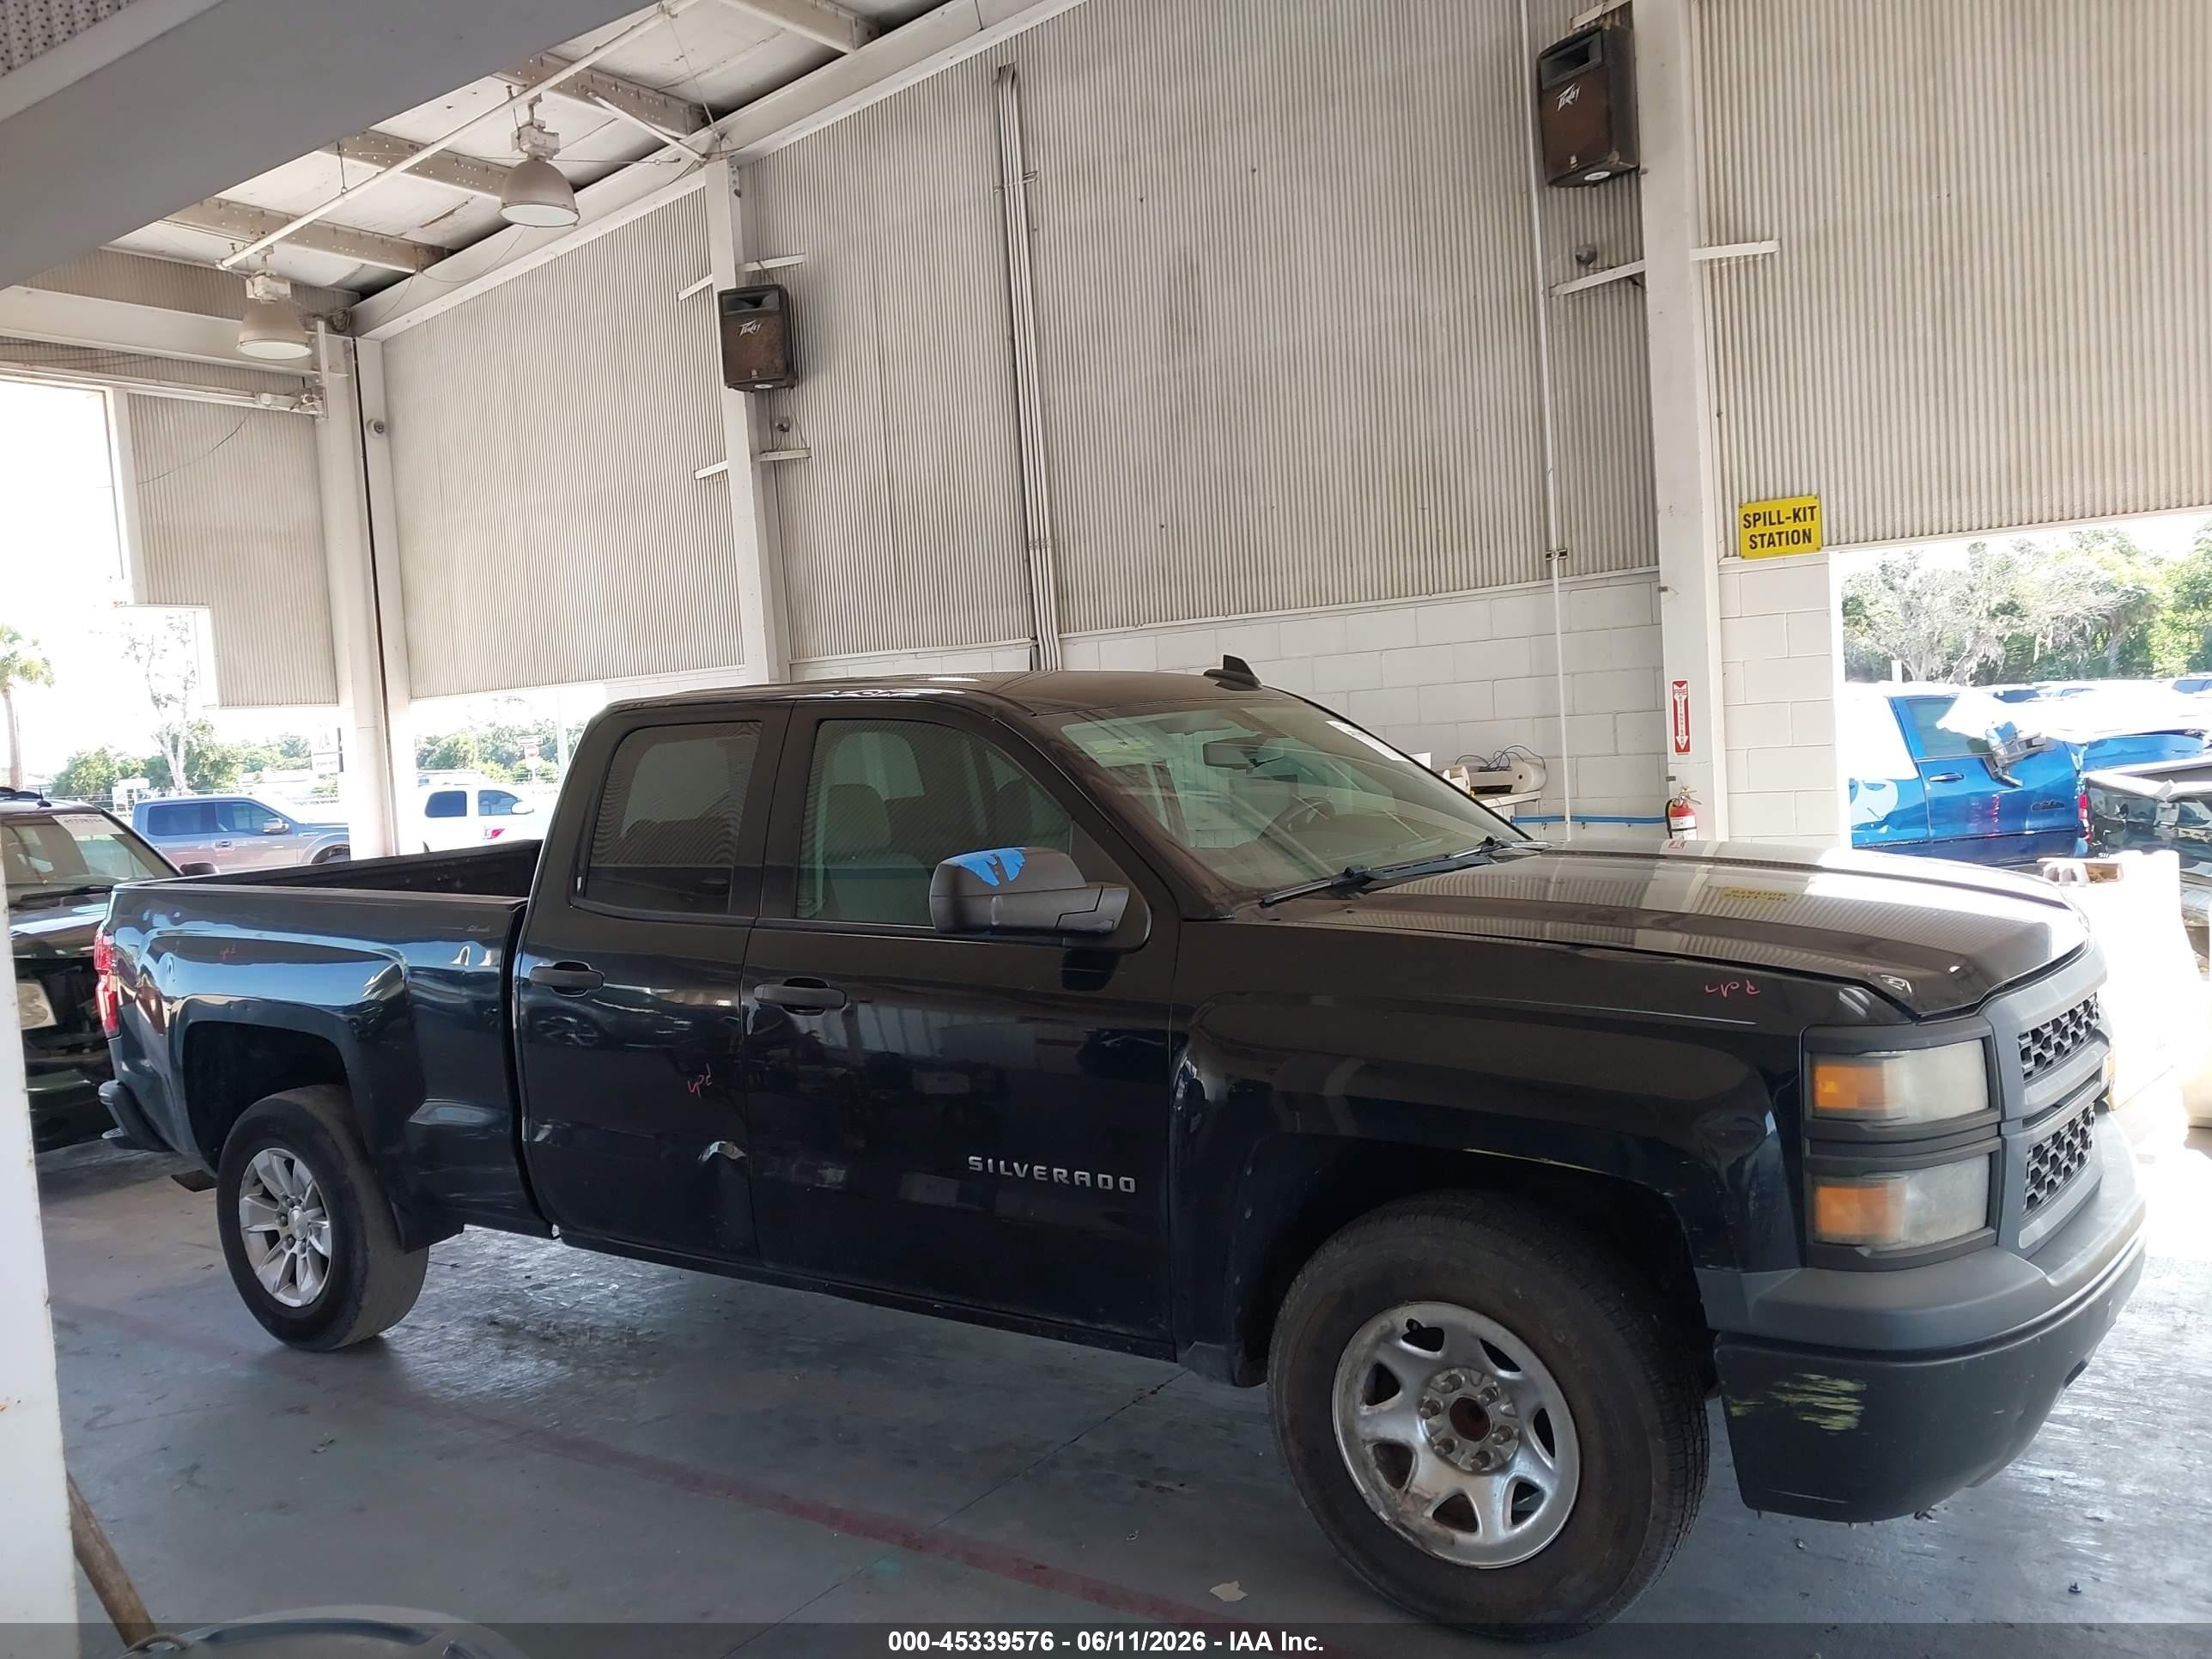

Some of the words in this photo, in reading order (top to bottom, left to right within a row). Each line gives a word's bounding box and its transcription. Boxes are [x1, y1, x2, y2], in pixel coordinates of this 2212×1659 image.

[1743, 506, 1817, 529] SPILL-KIT
[1749, 528, 1812, 550] STATION
[969, 1156, 1136, 1193] SILVERADO
